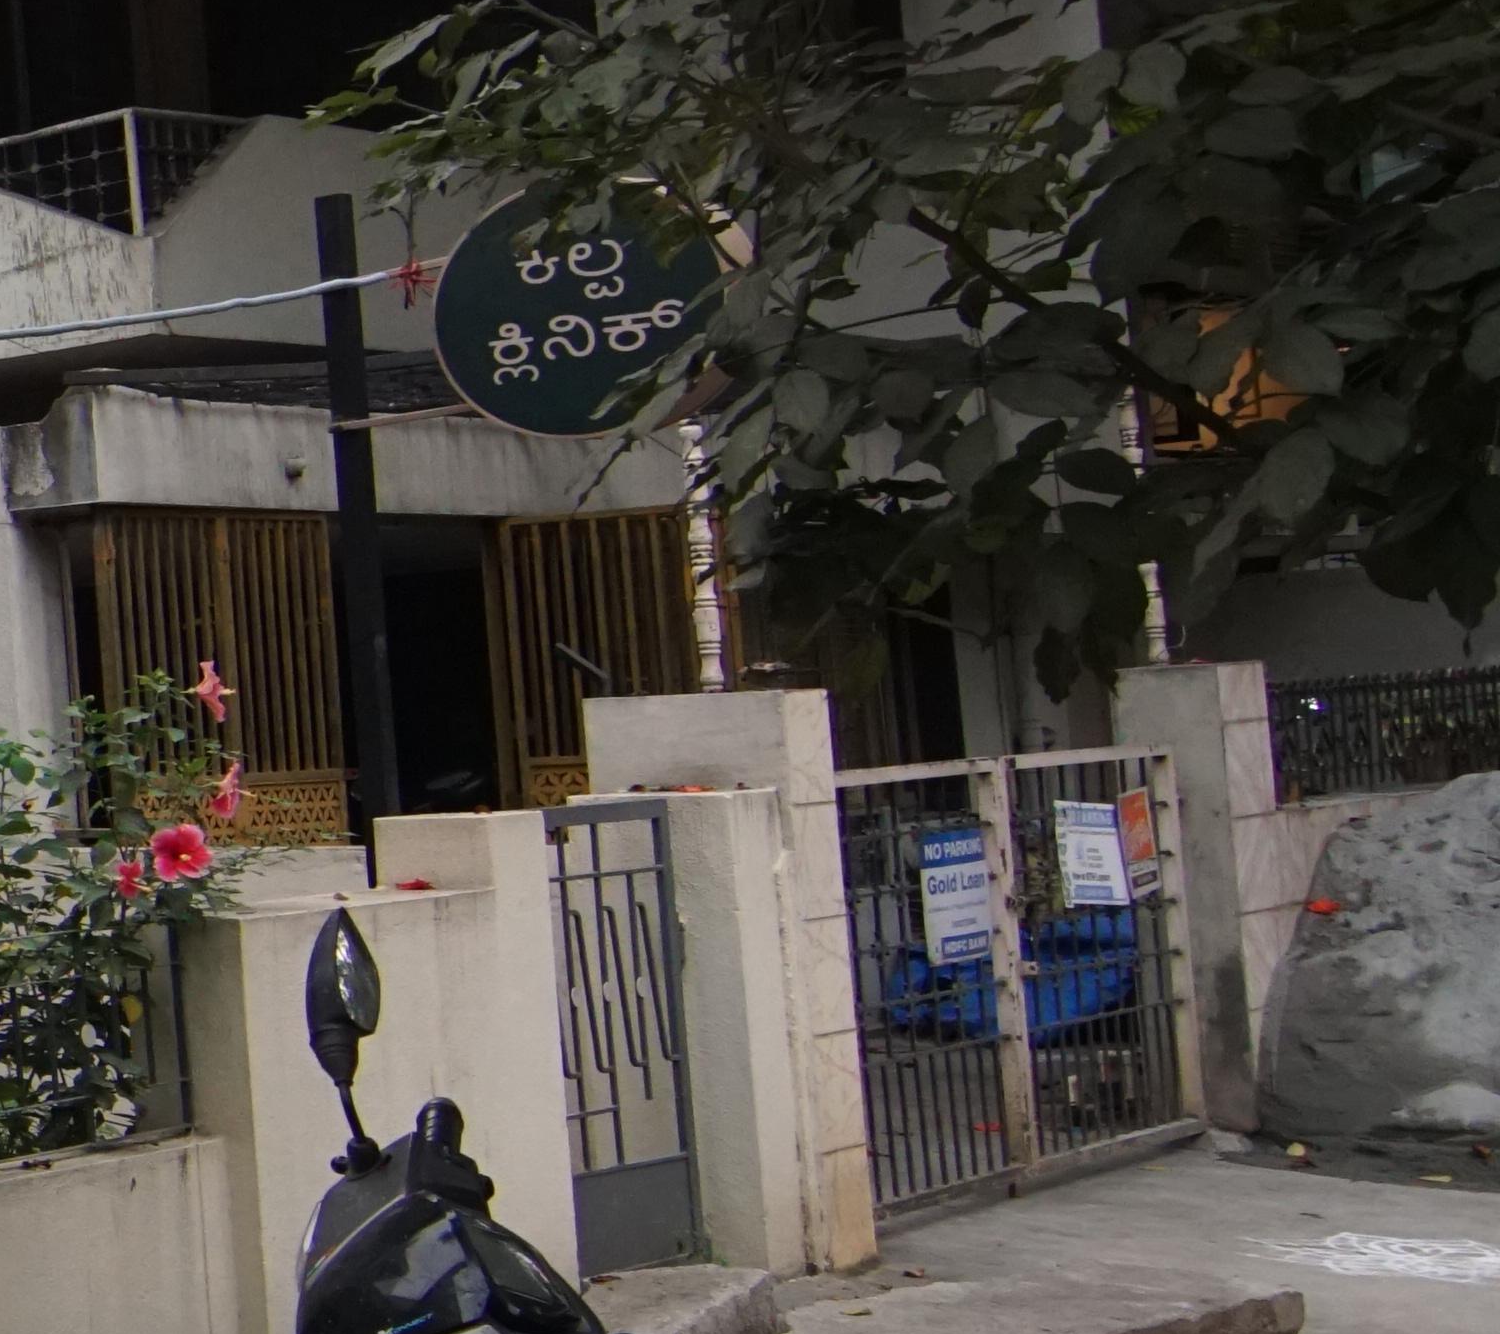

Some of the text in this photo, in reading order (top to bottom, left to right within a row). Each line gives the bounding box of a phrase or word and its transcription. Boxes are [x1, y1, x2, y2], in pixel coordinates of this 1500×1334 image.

[516, 239, 625, 300] ಕಲ್ಪ
[488, 298, 684, 386] ಕ್ಲಿನಿಕ್
[924, 843, 942, 861] NO
[927, 870, 985, 896] Gold Loan
